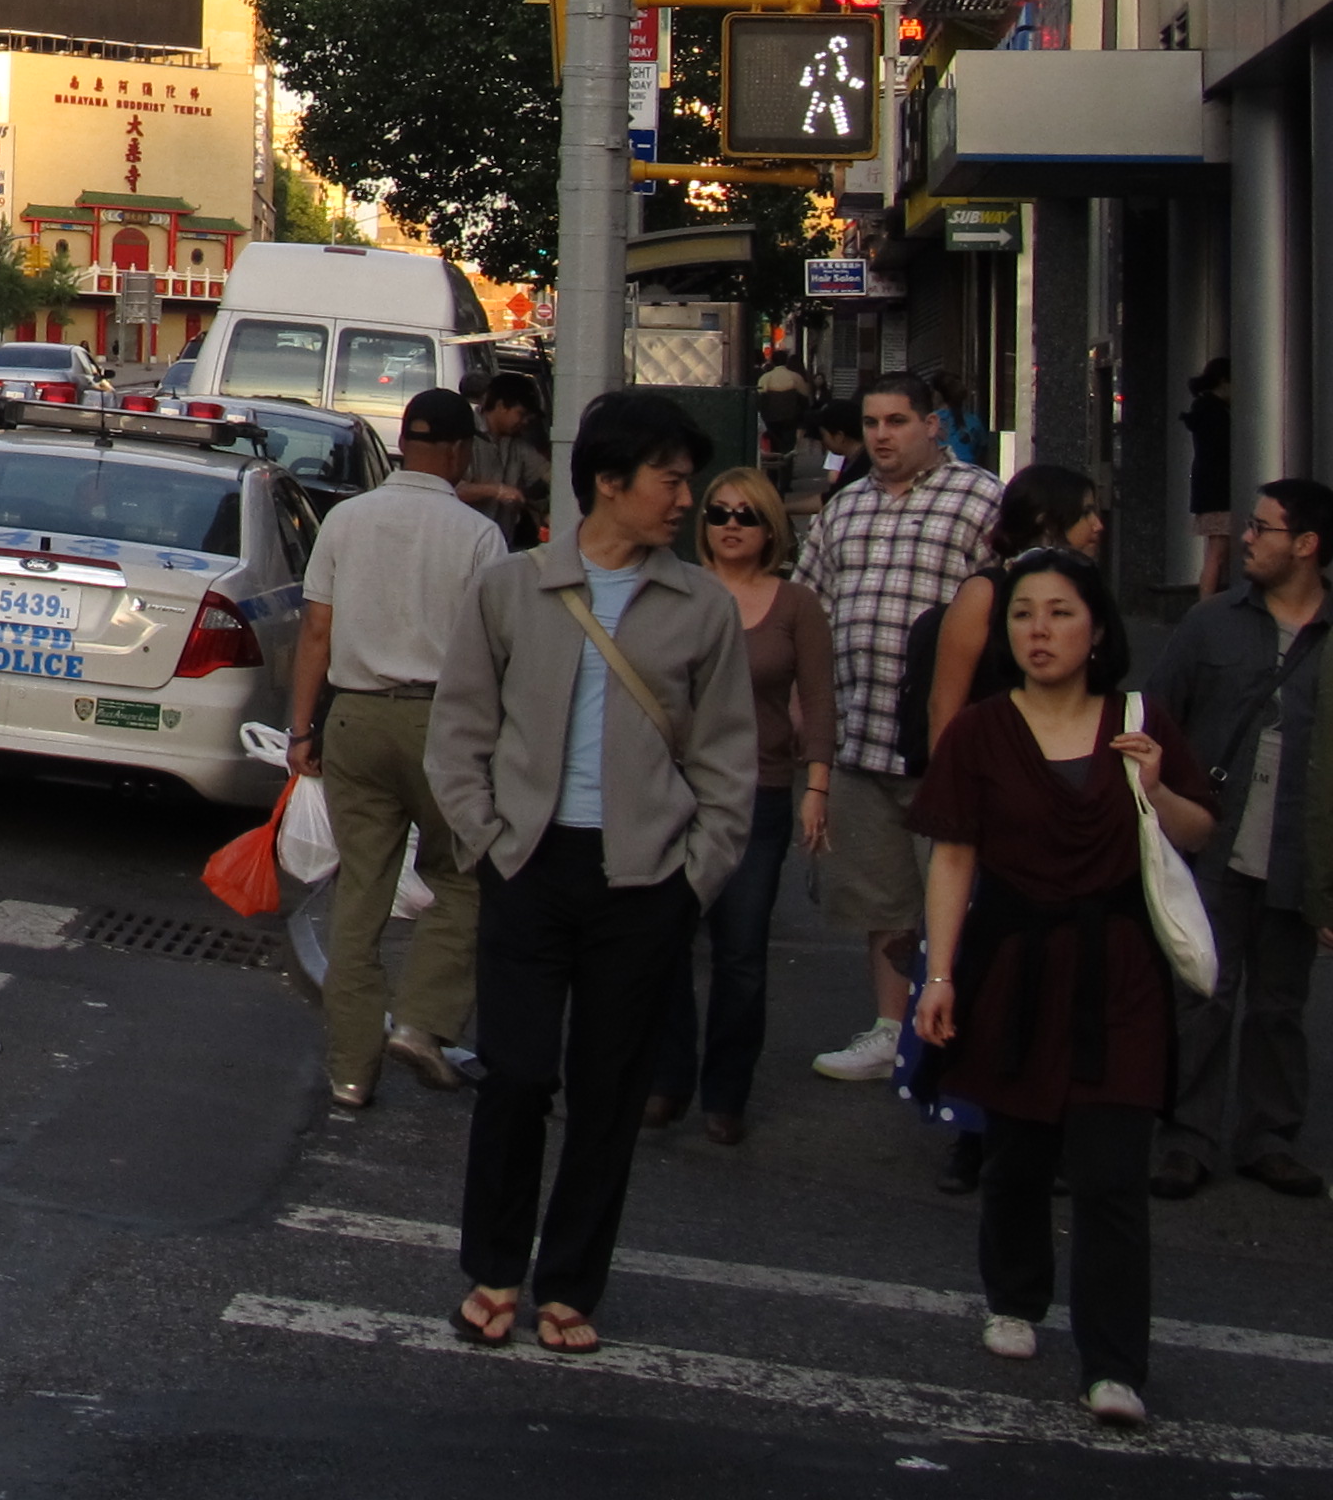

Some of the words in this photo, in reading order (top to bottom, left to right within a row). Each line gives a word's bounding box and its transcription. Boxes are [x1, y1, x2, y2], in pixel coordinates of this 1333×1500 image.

[54, 93, 109, 108] MAHAYANA
[116, 99, 166, 114] BUDDHIST
[173, 104, 213, 118] TEMPLE
[949, 211, 1018, 226] SUBWAY
[811, 274, 832, 283] Hair
[833, 274, 861, 283] Salon
